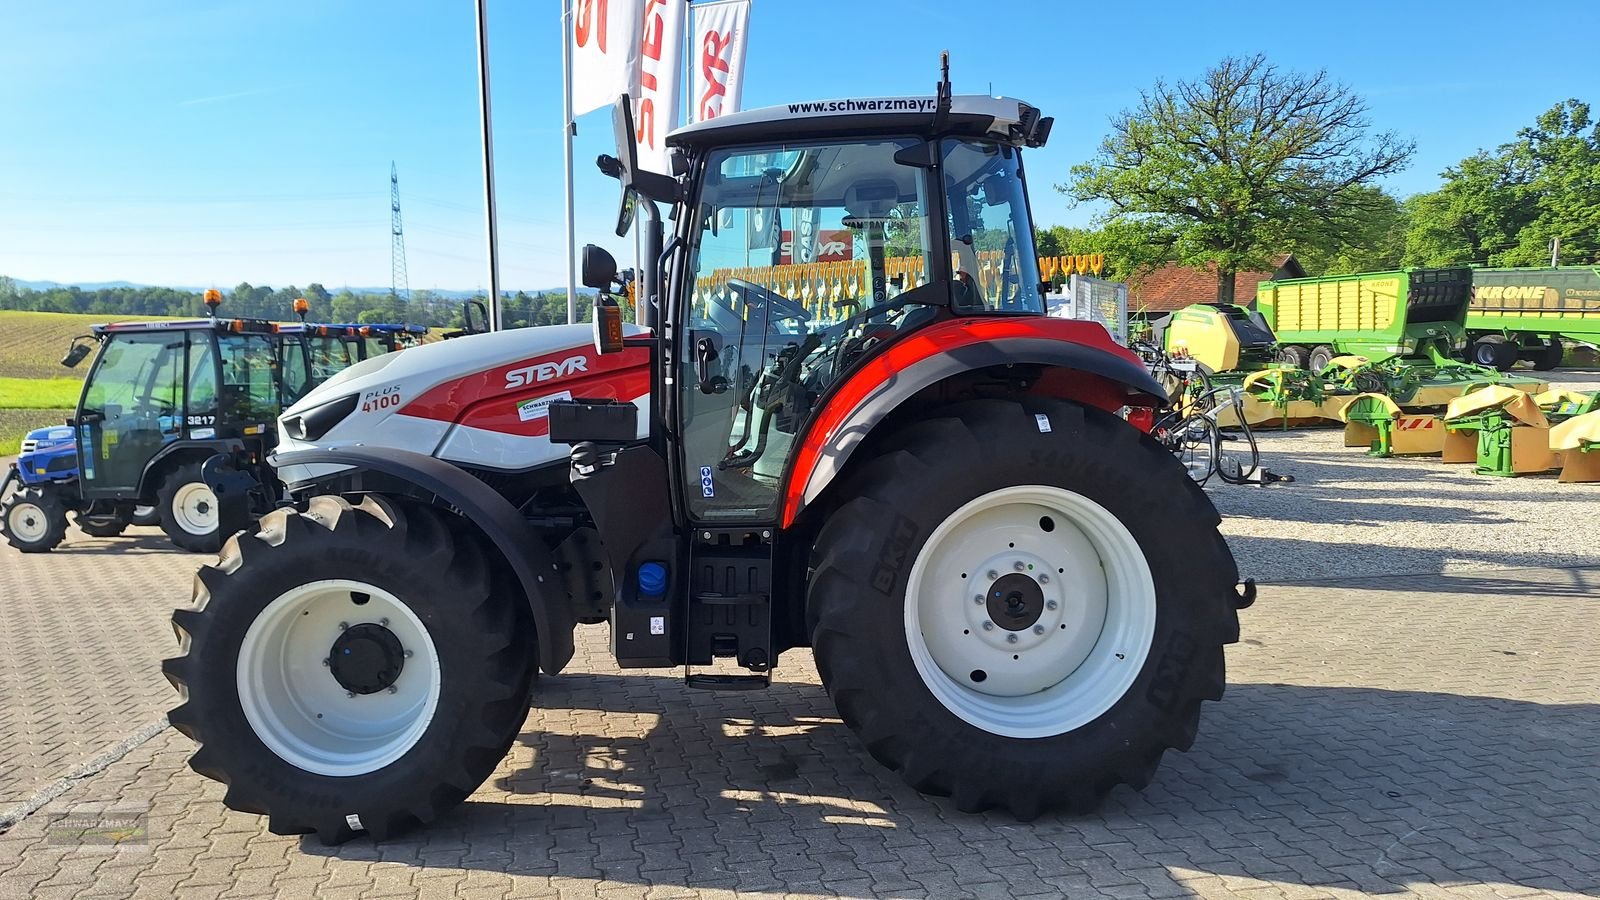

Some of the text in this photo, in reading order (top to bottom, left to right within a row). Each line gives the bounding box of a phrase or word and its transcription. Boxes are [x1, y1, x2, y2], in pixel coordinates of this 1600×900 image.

[788, 99, 936, 113] www.schwarzmayr.
[1476, 286, 1547, 299] KRONE
[504, 355, 588, 389] STEYR
[365, 384, 401, 400] PLUS
[362, 393, 400, 412] 4100
[187, 415, 215, 425] 3217
